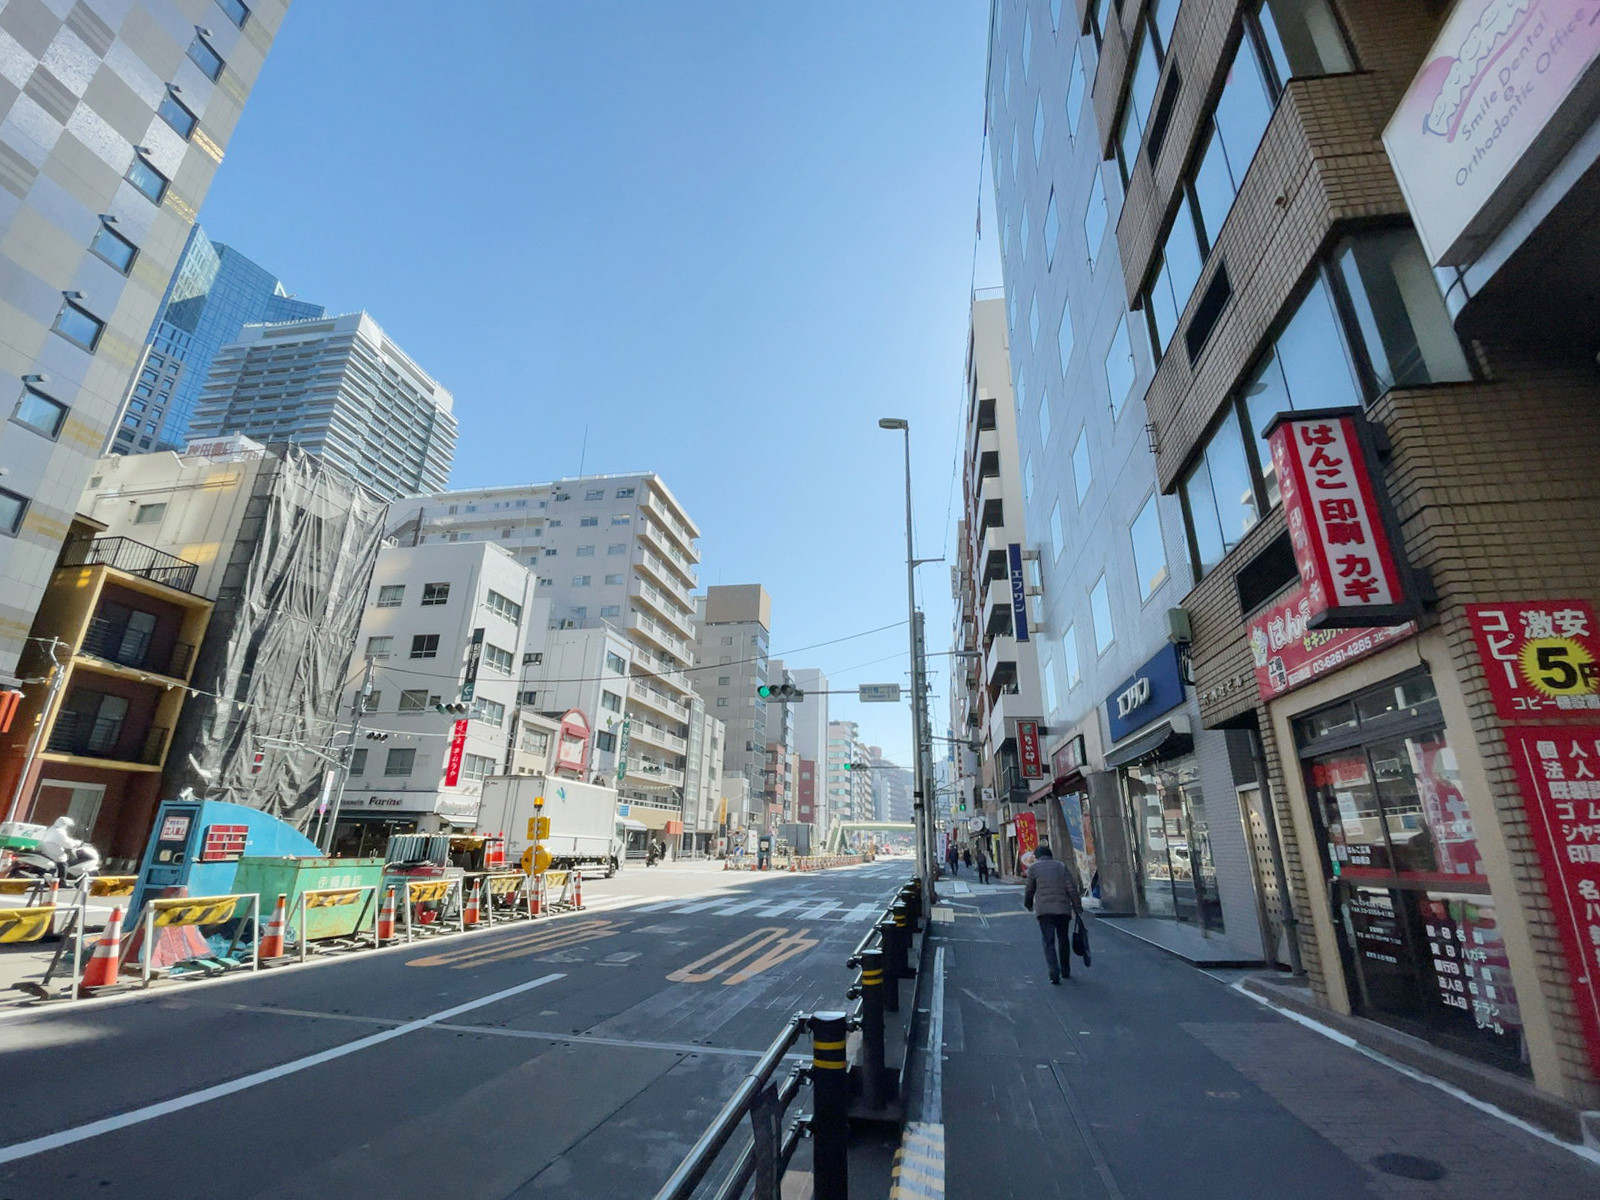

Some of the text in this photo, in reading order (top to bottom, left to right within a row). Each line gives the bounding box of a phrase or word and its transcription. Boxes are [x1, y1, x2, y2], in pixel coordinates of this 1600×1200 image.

[1461, 9, 1550, 141] Smile Dental
[1455, 8, 1585, 187] Orthodontic Office
[1300, 424, 1380, 604] はんこ 印刷 カギ
[1519, 608, 1590, 639] 激安
[1313, 637, 1372, 674] 03-6261-4285
[1478, 610, 1518, 689] コピー
[368, 796, 403, 806] Farine
[1461, 947, 1487, 963] ハガキ
[1441, 992, 1468, 1010] ゴム印
[1472, 1000, 1500, 1016] チラシ
[1475, 1017, 1504, 1035] シール
